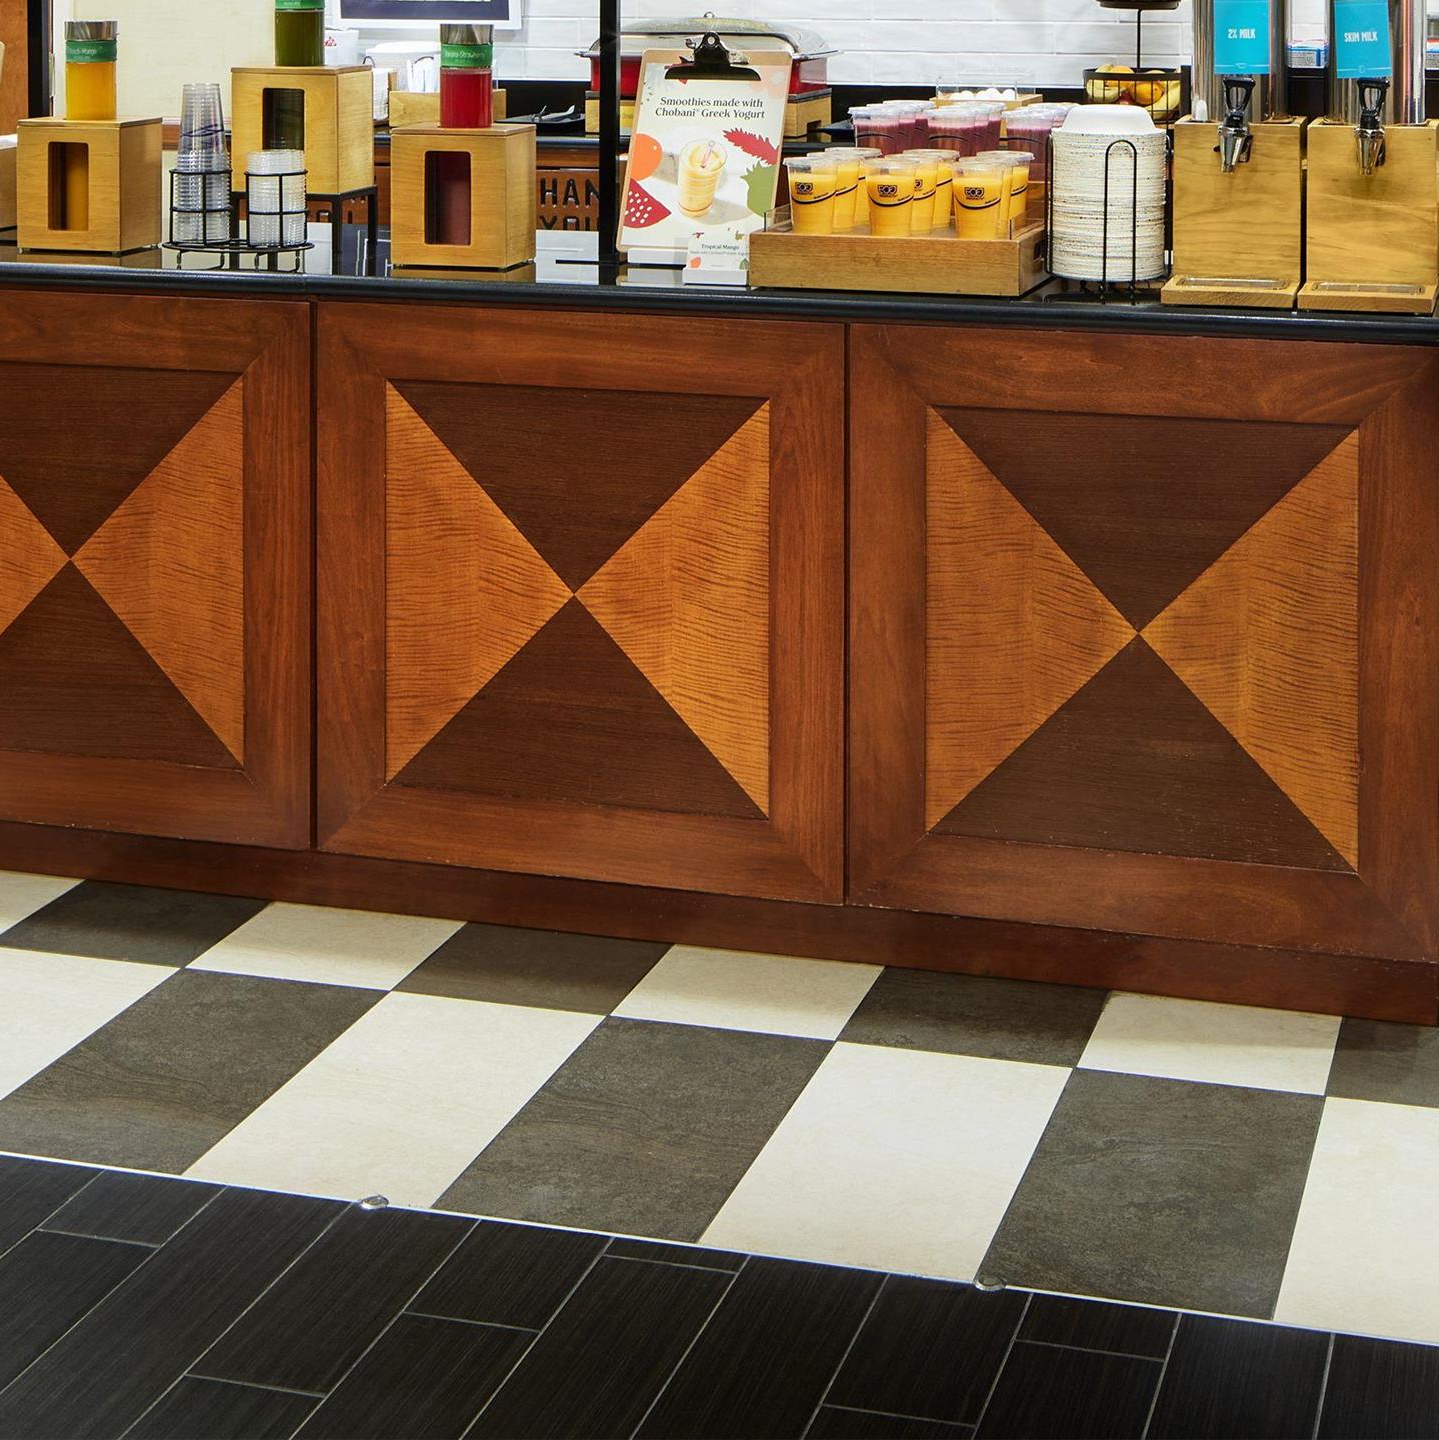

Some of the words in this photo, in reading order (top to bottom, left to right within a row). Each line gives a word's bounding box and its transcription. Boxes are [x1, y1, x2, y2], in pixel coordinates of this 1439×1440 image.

[1227, 28, 1237, 39] 2%
[1239, 28, 1256, 39] MILK
[1344, 32, 1359, 43] SKIM
[1361, 31, 1377, 42] MILK
[660, 97, 711, 106] Smoothies
[713, 98, 740, 107] made
[742, 99, 763, 108] with
[701, 108, 731, 118] Greek
[733, 109, 765, 120] Yogurt
